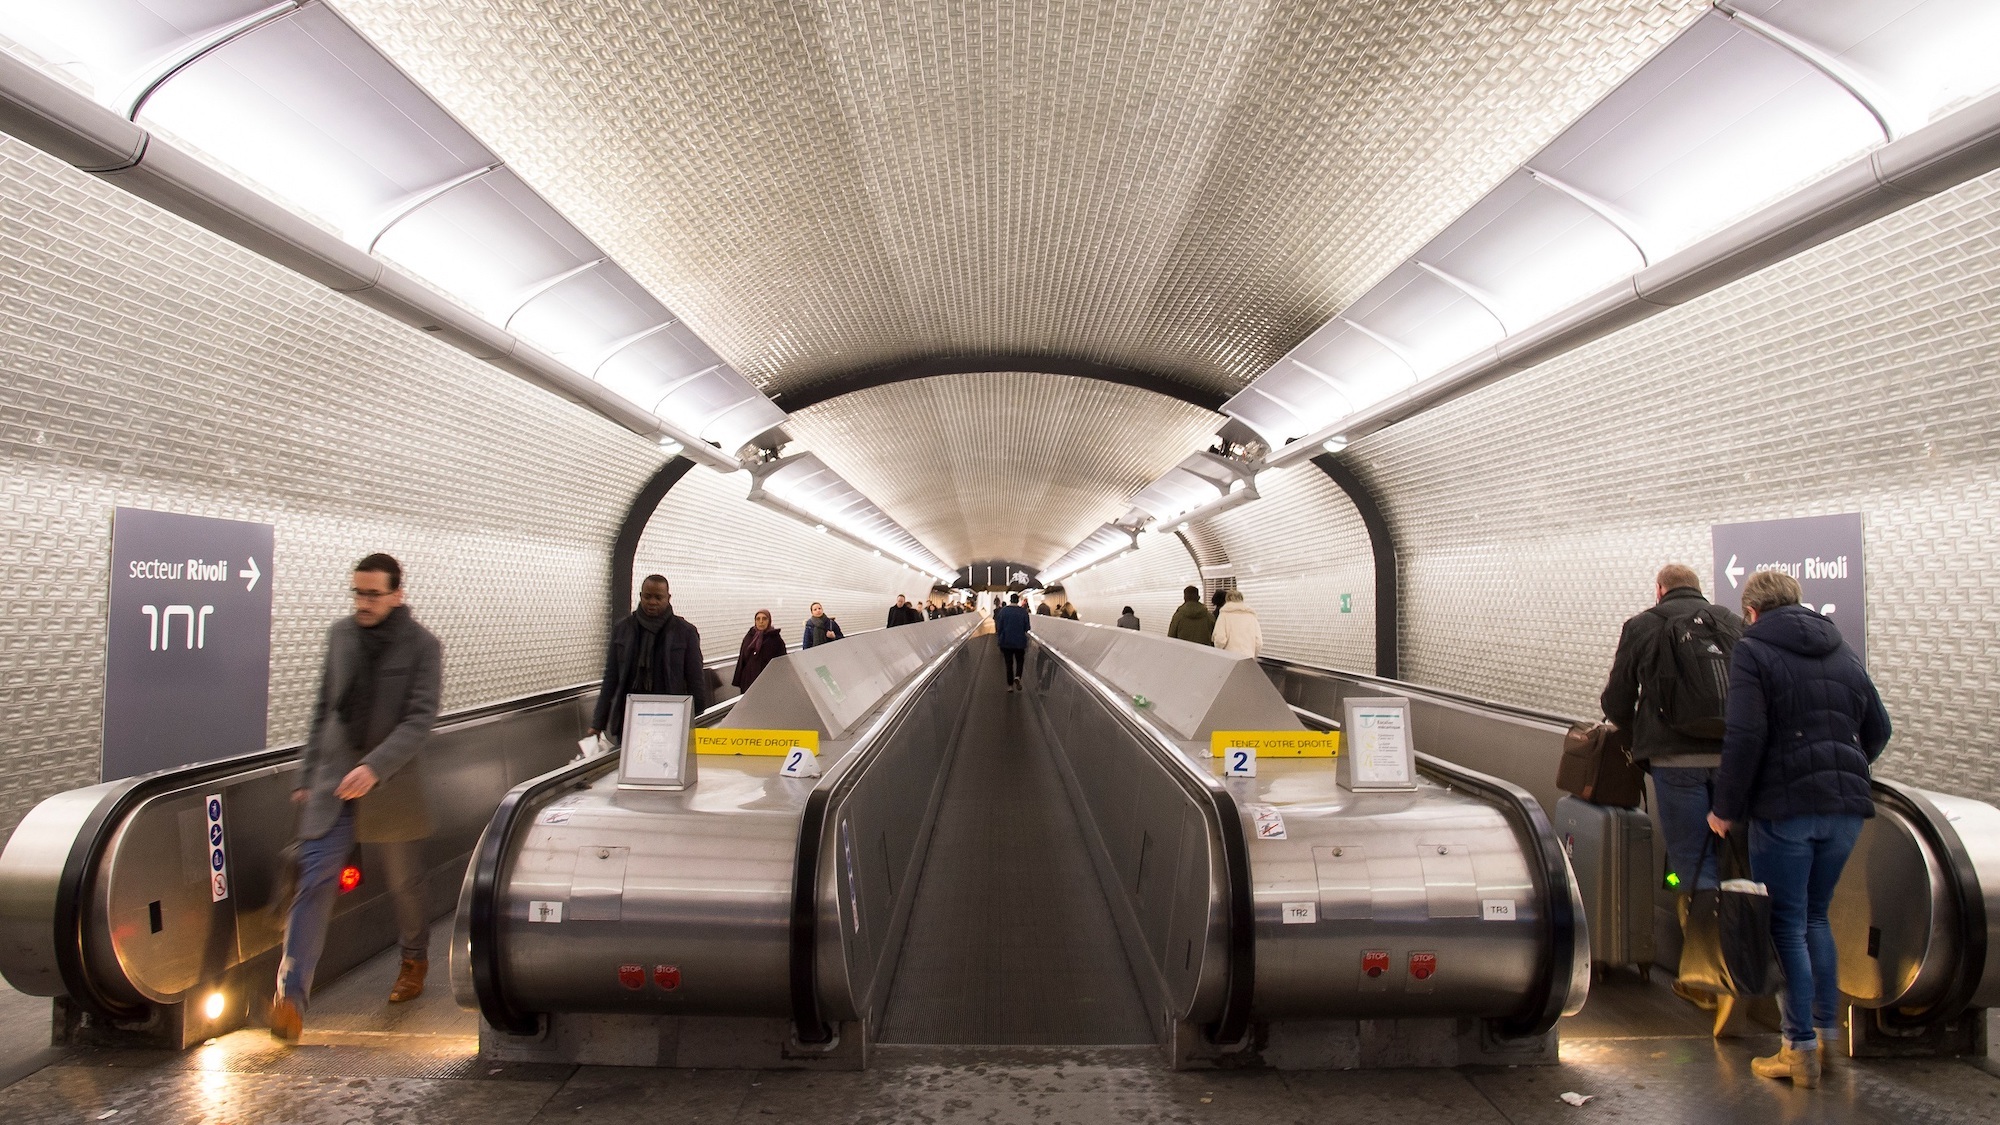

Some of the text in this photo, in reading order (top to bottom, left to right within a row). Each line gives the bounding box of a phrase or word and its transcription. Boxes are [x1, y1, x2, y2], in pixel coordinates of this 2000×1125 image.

[129, 558, 228, 582] secteur Rivoli
[1804, 555, 1848, 580] Rivoli
[698, 737, 800, 748] TENEZ VOTRE DROITE
[1230, 739, 1333, 748] TENEZ VOTRE DROITE
[787, 751, 803, 772] 2
[1233, 751, 1248, 772] 2
[538, 907, 554, 916] TR1
[1290, 908, 1308, 918] TR2
[1490, 905, 1508, 914] TR3
[1366, 952, 1387, 960] STOP
[1413, 954, 1434, 962] STOP
[621, 965, 642, 973] STOP
[656, 965, 677, 974] STOP
